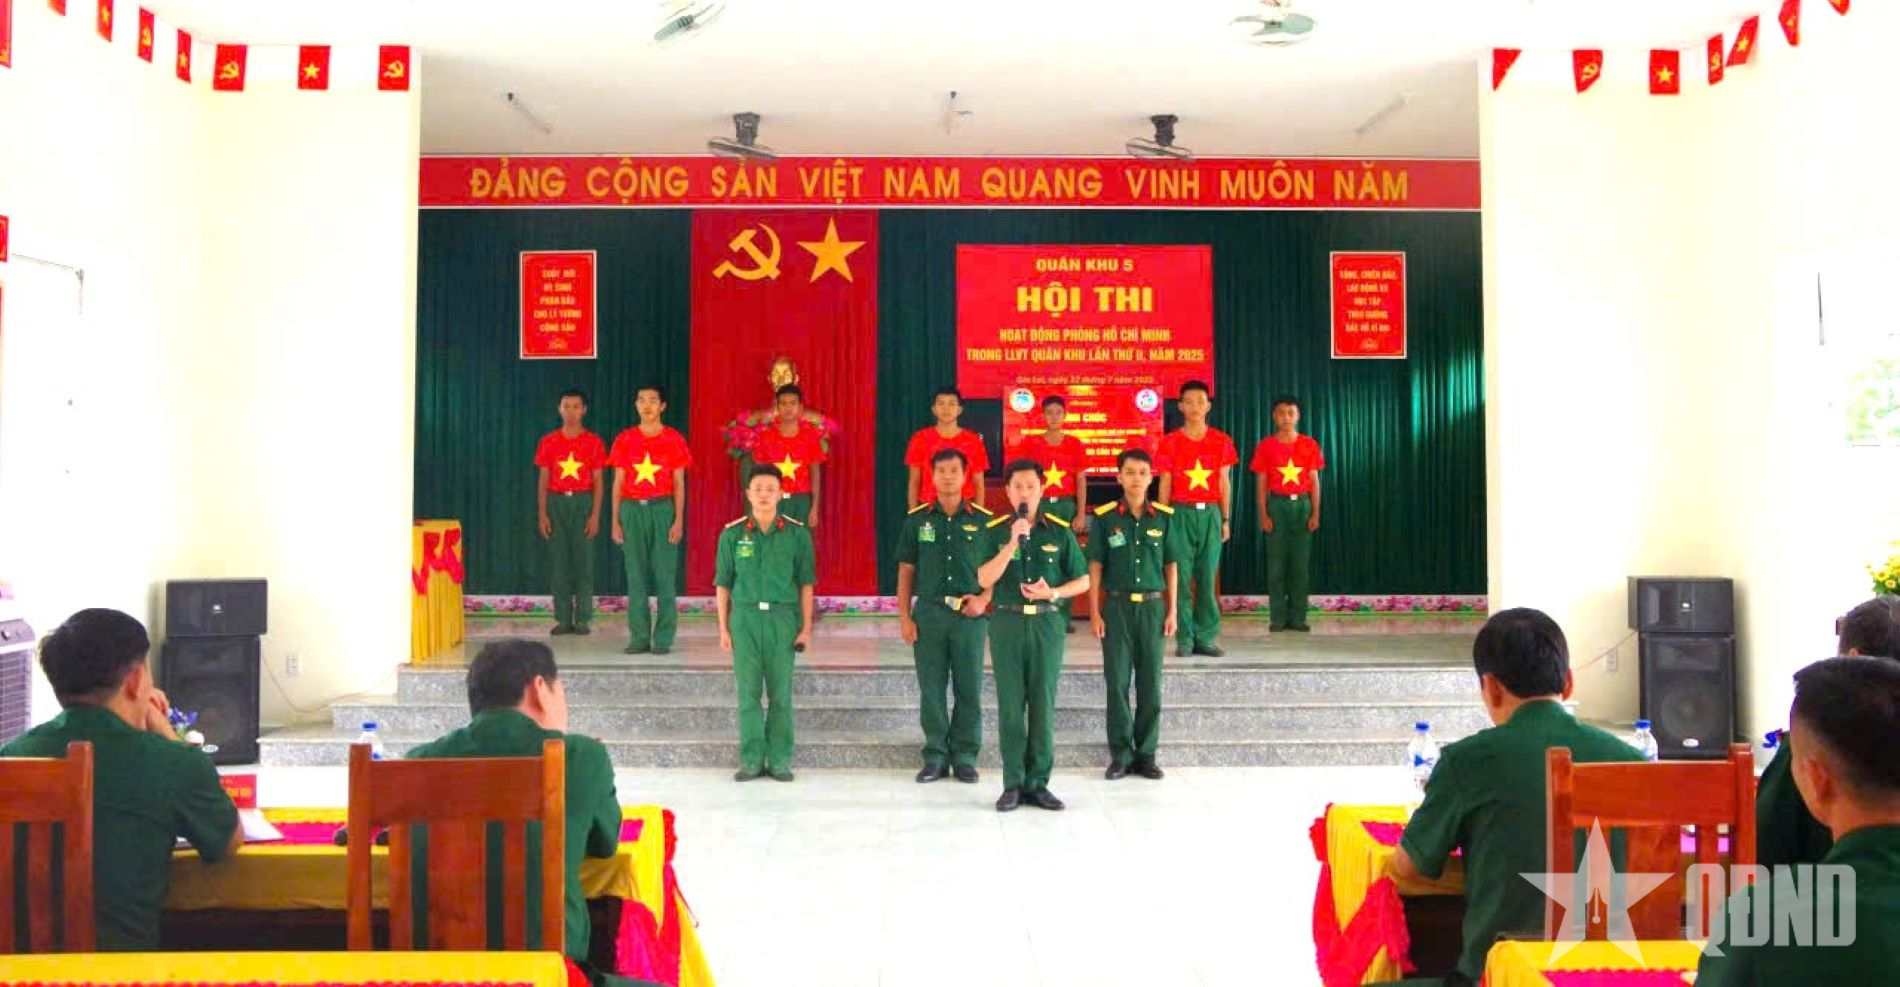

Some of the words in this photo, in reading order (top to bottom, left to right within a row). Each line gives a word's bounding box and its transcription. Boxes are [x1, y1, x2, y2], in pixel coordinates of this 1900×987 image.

[470, 157, 567, 198] ĐẢNG
[586, 158, 690, 204] CỘNG
[711, 157, 777, 198] SẢN
[800, 160, 863, 204] VIỆT
[884, 167, 960, 198] NAM
[981, 166, 1104, 199] QUANG
[1126, 167, 1200, 199] VINH
[1220, 160, 1315, 200] MUÔN
[1334, 160, 1408, 200] NĂM
[1036, 256, 1081, 272] QUÂN
[1085, 258, 1119, 272] KHU
[1123, 258, 1134, 272] 5
[1016, 281, 1081, 318] HỘI
[1093, 286, 1153, 313] THI
[1030, 326, 1060, 344] ĐỘNG
[1063, 325, 1100, 342] PHÒNG
[1103, 325, 1117, 342] HỒ
[1120, 326, 1138, 342] CHÍ
[1141, 328, 1171, 342] MINH
[967, 348, 1002, 361] TRONG
[1005, 348, 1028, 361] LLVT
[1031, 347, 1061, 363] QUÂN
[1064, 348, 1086, 361] KHU
[1089, 346, 1110, 361] LẦN
[1113, 347, 1134, 361] THỨ
[1150, 346, 1175, 361] NĂM
[1178, 348, 1204, 361] 2025
